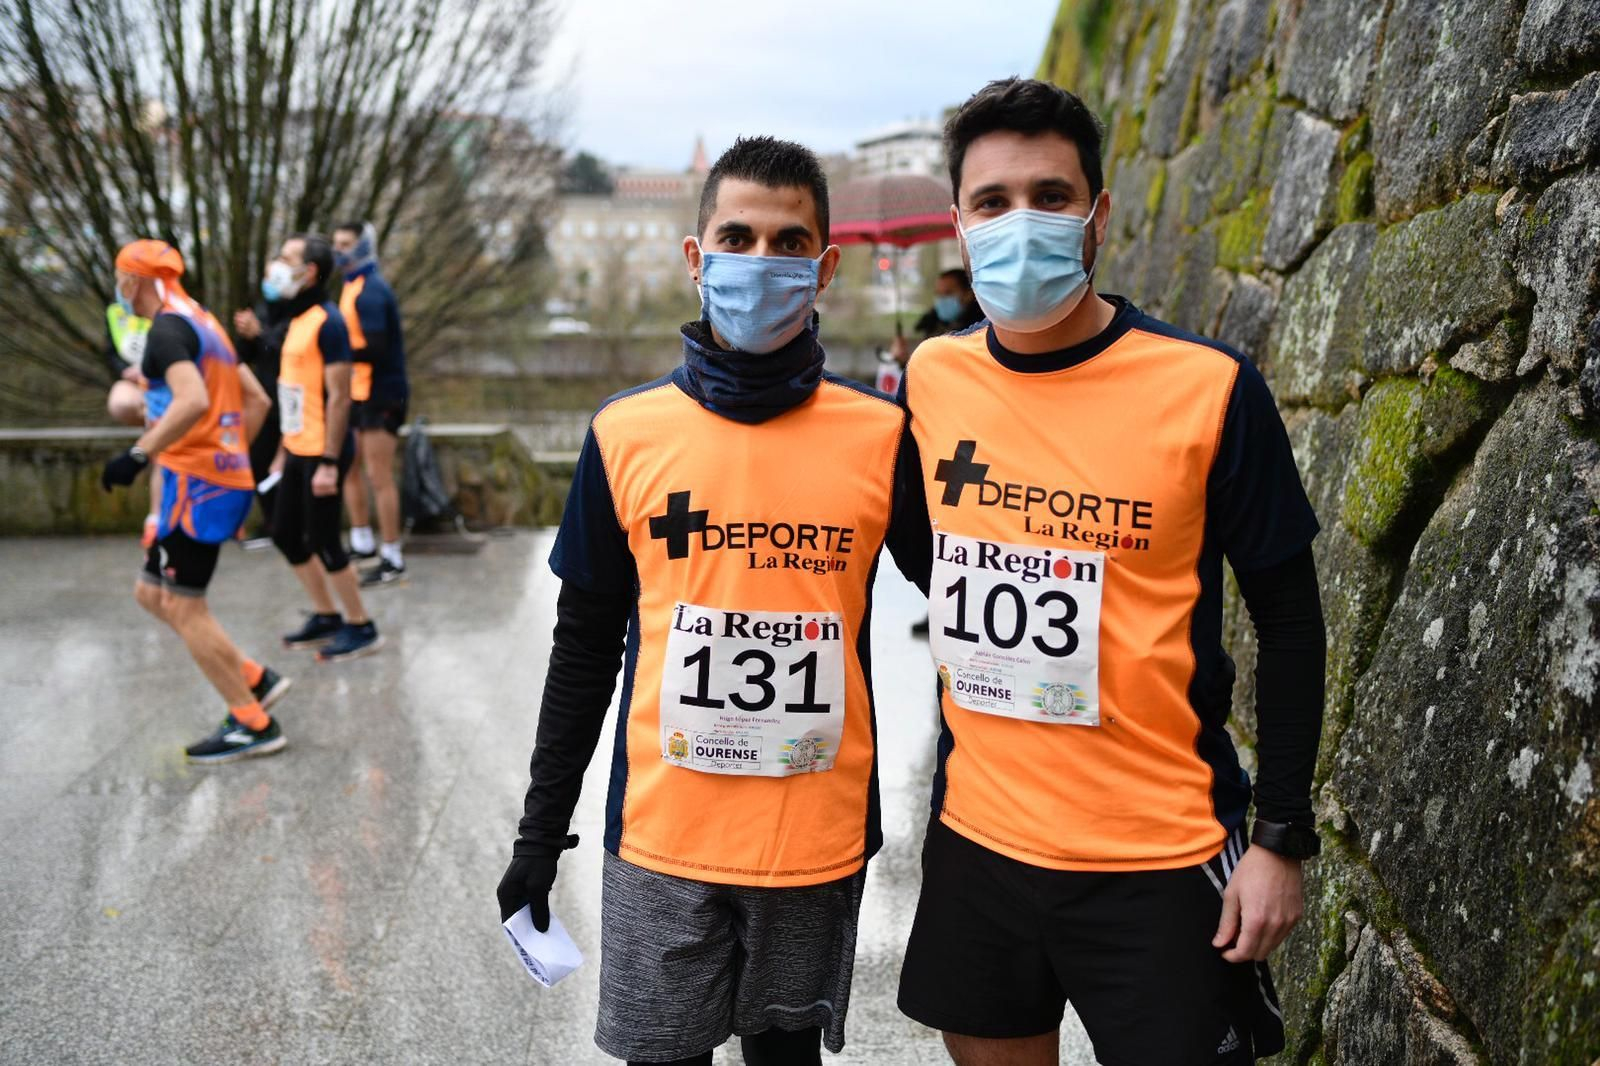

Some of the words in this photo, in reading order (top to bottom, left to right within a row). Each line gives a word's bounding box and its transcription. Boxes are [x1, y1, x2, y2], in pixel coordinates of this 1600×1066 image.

[978, 480, 1153, 530] DEPORTE
[702, 522, 854, 553] DEPORTE
[1024, 516, 1054, 537] La
[1061, 521, 1149, 550] Región
[748, 552, 778, 569] La
[936, 533, 968, 566] La
[976, 541, 1098, 584] Región
[673, 604, 713, 636] La
[721, 611, 841, 648] Región
[943, 575, 1080, 658] 103
[679, 645, 831, 713] 131
[956, 668, 990, 683] Concello
[992, 676, 1003, 685] de
[956, 680, 1012, 701] OURENSE
[695, 734, 735, 746] Concello
[737, 738, 749, 747] de
[695, 746, 758, 761] OURENSE
